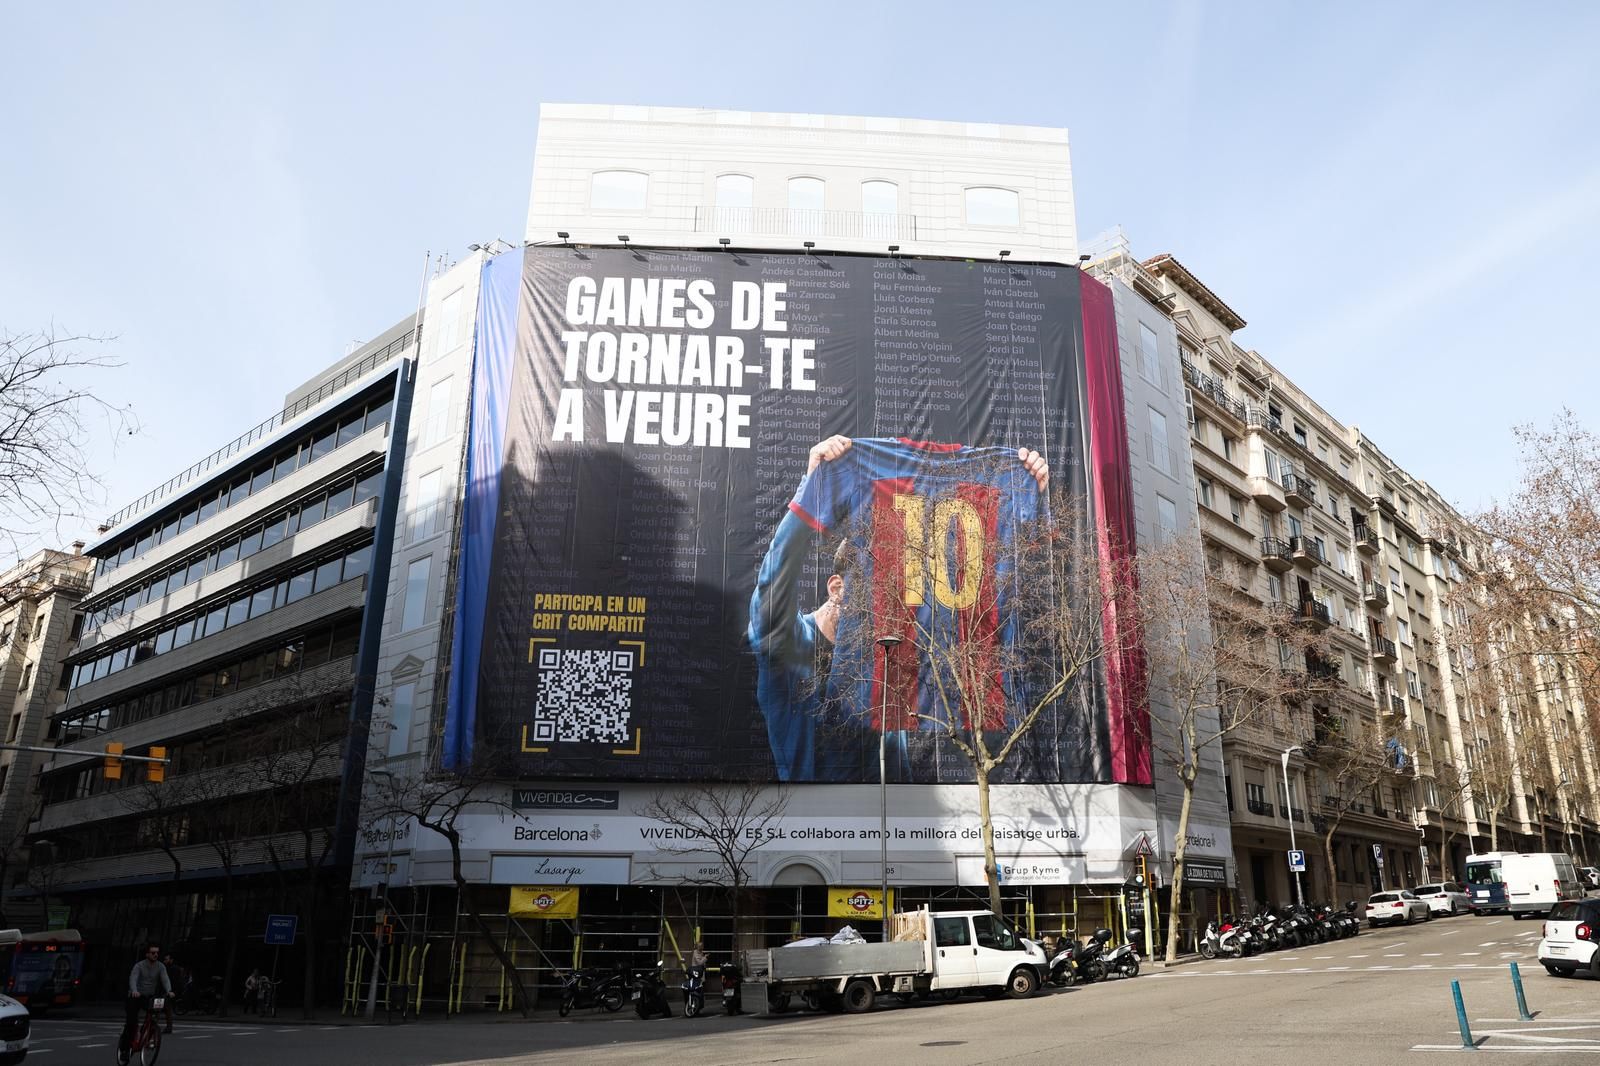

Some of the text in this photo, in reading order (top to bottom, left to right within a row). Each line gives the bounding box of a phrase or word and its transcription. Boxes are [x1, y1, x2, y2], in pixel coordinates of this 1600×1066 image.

[761, 256, 796, 265] Alberto
[874, 260, 897, 268] Jordi
[761, 267, 846, 278] Andrés Castelltort
[874, 271, 926, 281] Oriol Molas
[983, 265, 1006, 274] Marc
[1036, 268, 1056, 279] Roig
[829, 280, 851, 289] Solé
[983, 276, 1032, 286] Marc Duch
[873, 282, 943, 293] Pau Fernández
[984, 288, 1003, 296] Iván
[799, 290, 836, 300] Zarroca
[898, 294, 935, 304] Corbera
[565, 276, 787, 331] GANES DE
[790, 301, 810, 311] Roig
[984, 299, 1014, 308] Antoni
[874, 305, 933, 315] Jordi Mestre
[792, 313, 818, 323] Moya
[874, 316, 937, 327] Carla Surroca
[984, 310, 1043, 322] Pere Gallego
[791, 323, 830, 335] Anglada
[985, 321, 1037, 332] Joan Costa
[874, 328, 940, 339] Albert Medina
[985, 333, 1035, 344] Sergi Mata
[874, 339, 953, 352] Fernando Volpini
[987, 344, 1024, 354] Jordi Gil
[560, 331, 816, 392] TORNAR-TE
[874, 351, 961, 364] Juan Pablo Ortuño
[875, 363, 941, 374] Alberto Ponce
[987, 368, 1005, 377] Pau
[875, 375, 960, 387] Andrés Castelltort
[1012, 380, 1048, 391] Corbera
[760, 393, 849, 406] Juan Pablo Ortuño
[989, 393, 1011, 402] Jordi
[914, 401, 951, 411] Zarroca
[988, 403, 1032, 414] Fernando
[758, 406, 827, 418] Alberto Ponce
[552, 388, 751, 448] A VEURE
[903, 413, 925, 424] Roig
[989, 417, 1012, 427] Juan
[1015, 418, 1041, 428] Pablo
[758, 419, 820, 430] Joan Garrido
[1026, 430, 1056, 440] Ponce
[757, 443, 788, 454] Carles
[634, 452, 692, 462] Joan Costa
[757, 456, 784, 466] Salva
[634, 464, 689, 475] Sergi Mata
[757, 468, 779, 478] Pere
[694, 479, 717, 491] Roig
[756, 481, 781, 493] Joan
[755, 495, 782, 505] Enric
[895, 495, 984, 610] 10
[656, 559, 697, 569] Corbera
[534, 594, 602, 612] PARTICIPA
[607, 596, 624, 613] EN
[628, 597, 647, 614] UN
[532, 613, 646, 633] CRIT COMPARTIT
[367, 829, 403, 844] Barcelna
[514, 826, 588, 841] Barcelona
[640, 827, 705, 840] VIVENDA
[895, 827, 906, 840] la
[910, 827, 957, 840] millora
[961, 827, 982, 840] del
[991, 828, 1042, 843] aisatge
[1291, 853, 1300, 864] P
[1004, 865, 1060, 876] Grup Ryme
[533, 898, 556, 906] SPITZ
[848, 897, 874, 906] SPITZ
